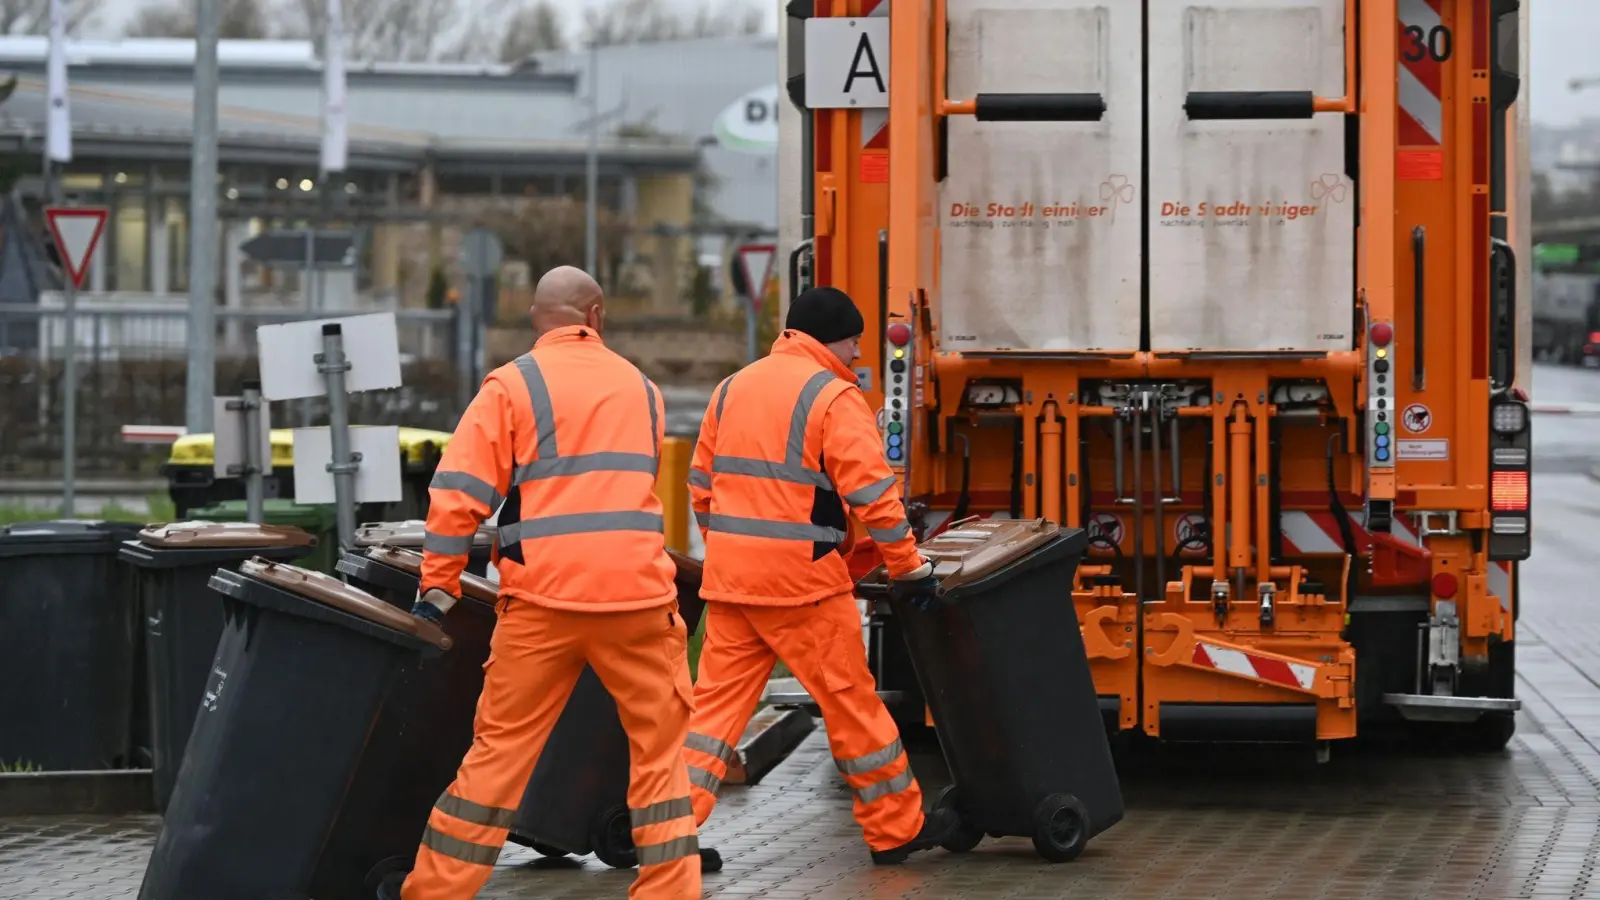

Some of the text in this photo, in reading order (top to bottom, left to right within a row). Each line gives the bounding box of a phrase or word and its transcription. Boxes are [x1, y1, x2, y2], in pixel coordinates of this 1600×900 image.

[1402, 24, 1452, 63] 30
[842, 32, 887, 93] A
[951, 202, 980, 217] Die
[1161, 201, 1191, 216] Die
